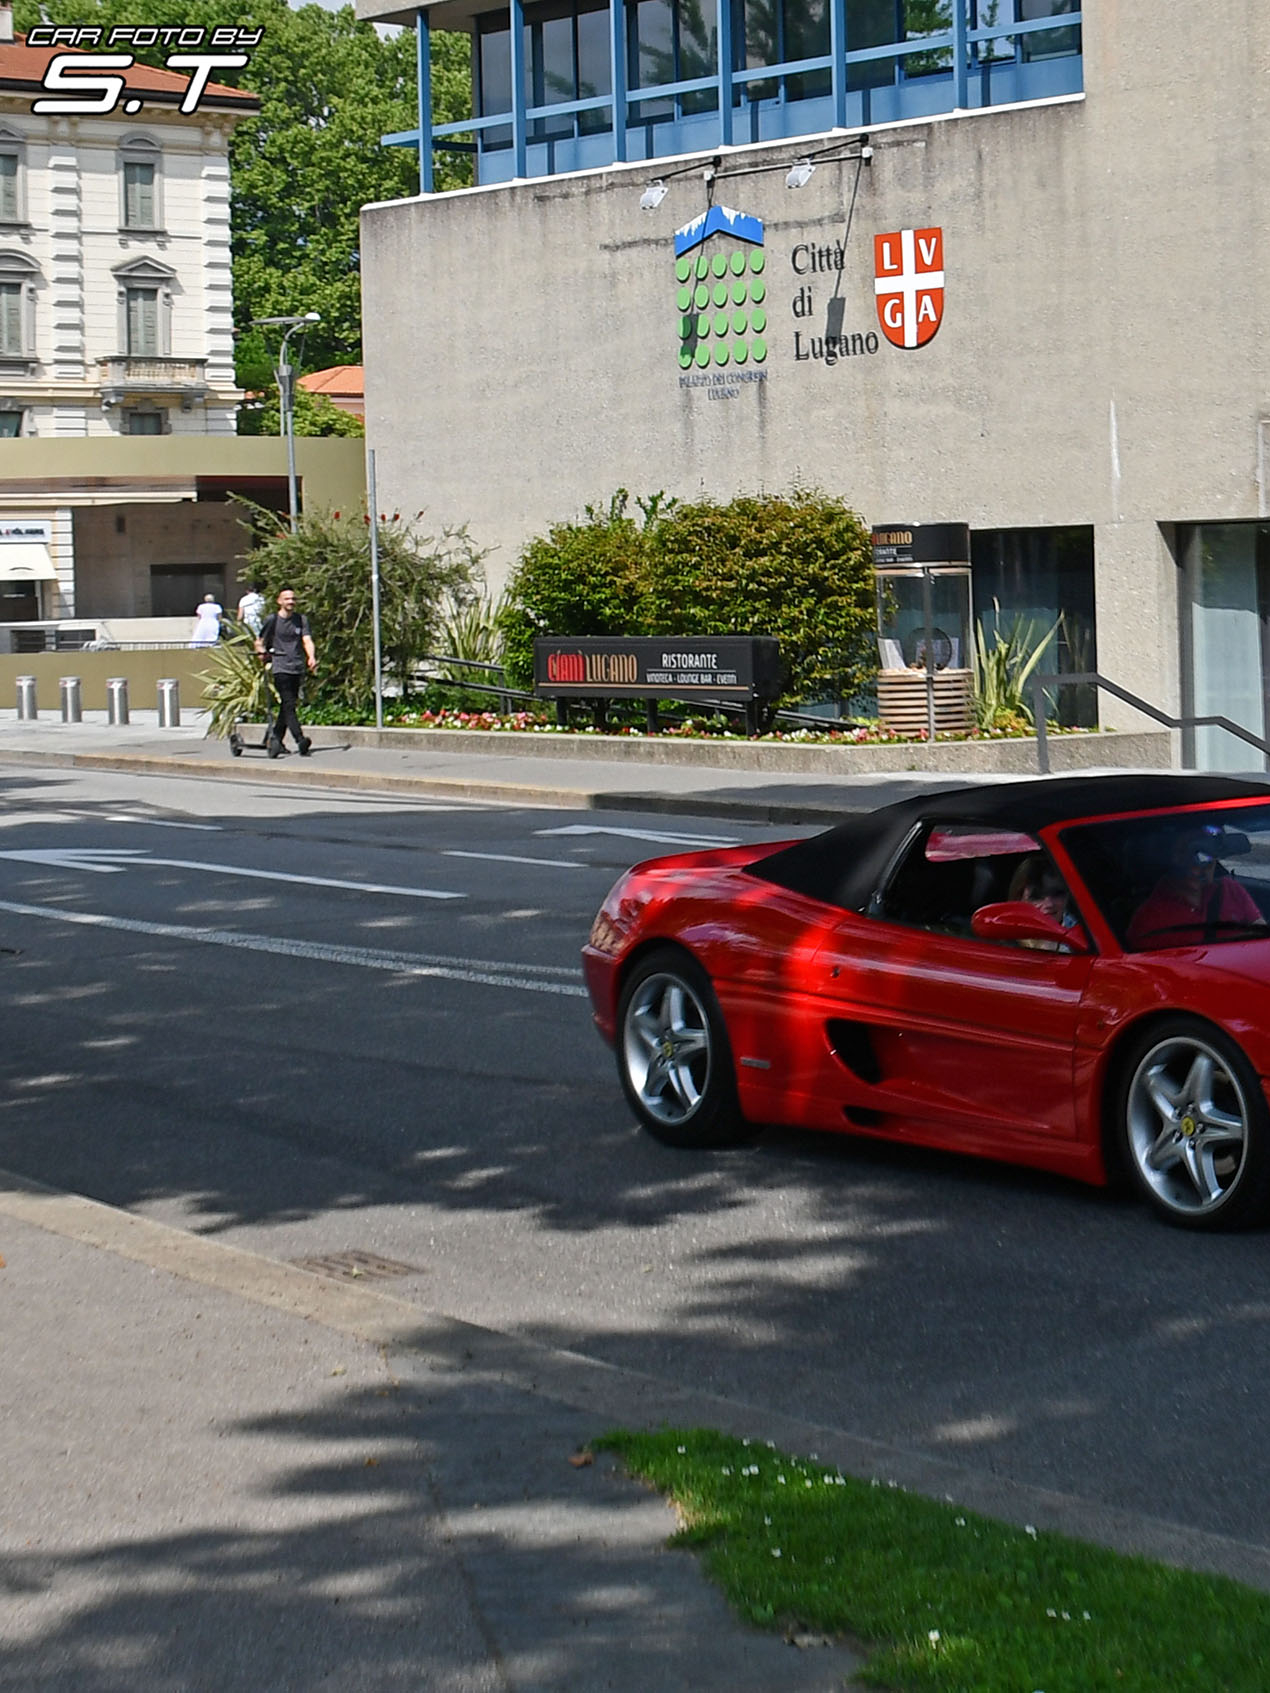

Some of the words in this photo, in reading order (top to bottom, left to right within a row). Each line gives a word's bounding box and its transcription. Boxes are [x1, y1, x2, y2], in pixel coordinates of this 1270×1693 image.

[791, 240, 845, 275] Città
[792, 286, 813, 318] di
[794, 331, 879, 366] Lugano
[662, 654, 718, 669] RISTORANTE
[701, 674, 713, 684] BAR
